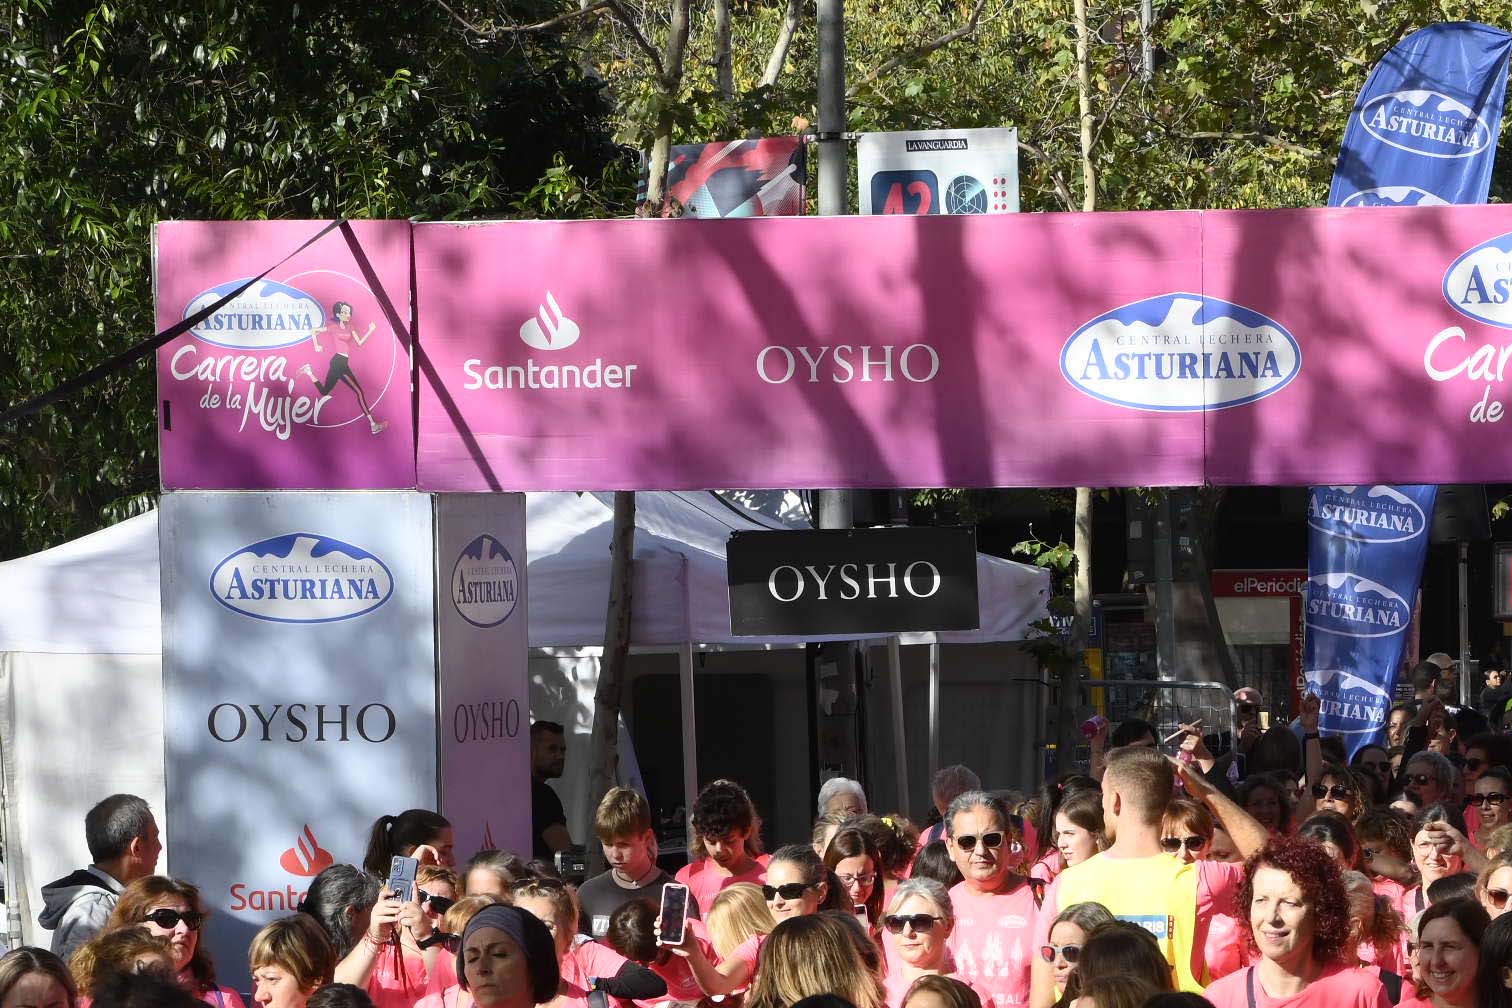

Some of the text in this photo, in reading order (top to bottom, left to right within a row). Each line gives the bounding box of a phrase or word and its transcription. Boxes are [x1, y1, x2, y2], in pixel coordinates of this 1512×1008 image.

[1369, 104, 1480, 148] ASTURIANA
[1393, 106, 1435, 120] CENTRAL
[917, 139, 967, 150] VANGUARDIA
[195, 304, 313, 331] ASTURIANA
[1115, 333, 1275, 346] CENTRAL LECHERA
[171, 344, 287, 381] Carrera
[463, 358, 637, 390] Santander
[756, 343, 940, 385] OYSHO
[1080, 338, 1282, 381] ASTURIANA
[200, 379, 332, 440] de la Mujer
[1470, 385, 1504, 424] de
[1308, 493, 1415, 532] ASTURIANA
[225, 566, 380, 601] ASTURIANA
[253, 564, 375, 574] CENTRAL LECHERA
[456, 569, 514, 605] ASTURIANA
[768, 561, 942, 602] OYSHO
[207, 702, 396, 744] OYSHO
[454, 698, 520, 744] OYSHO
